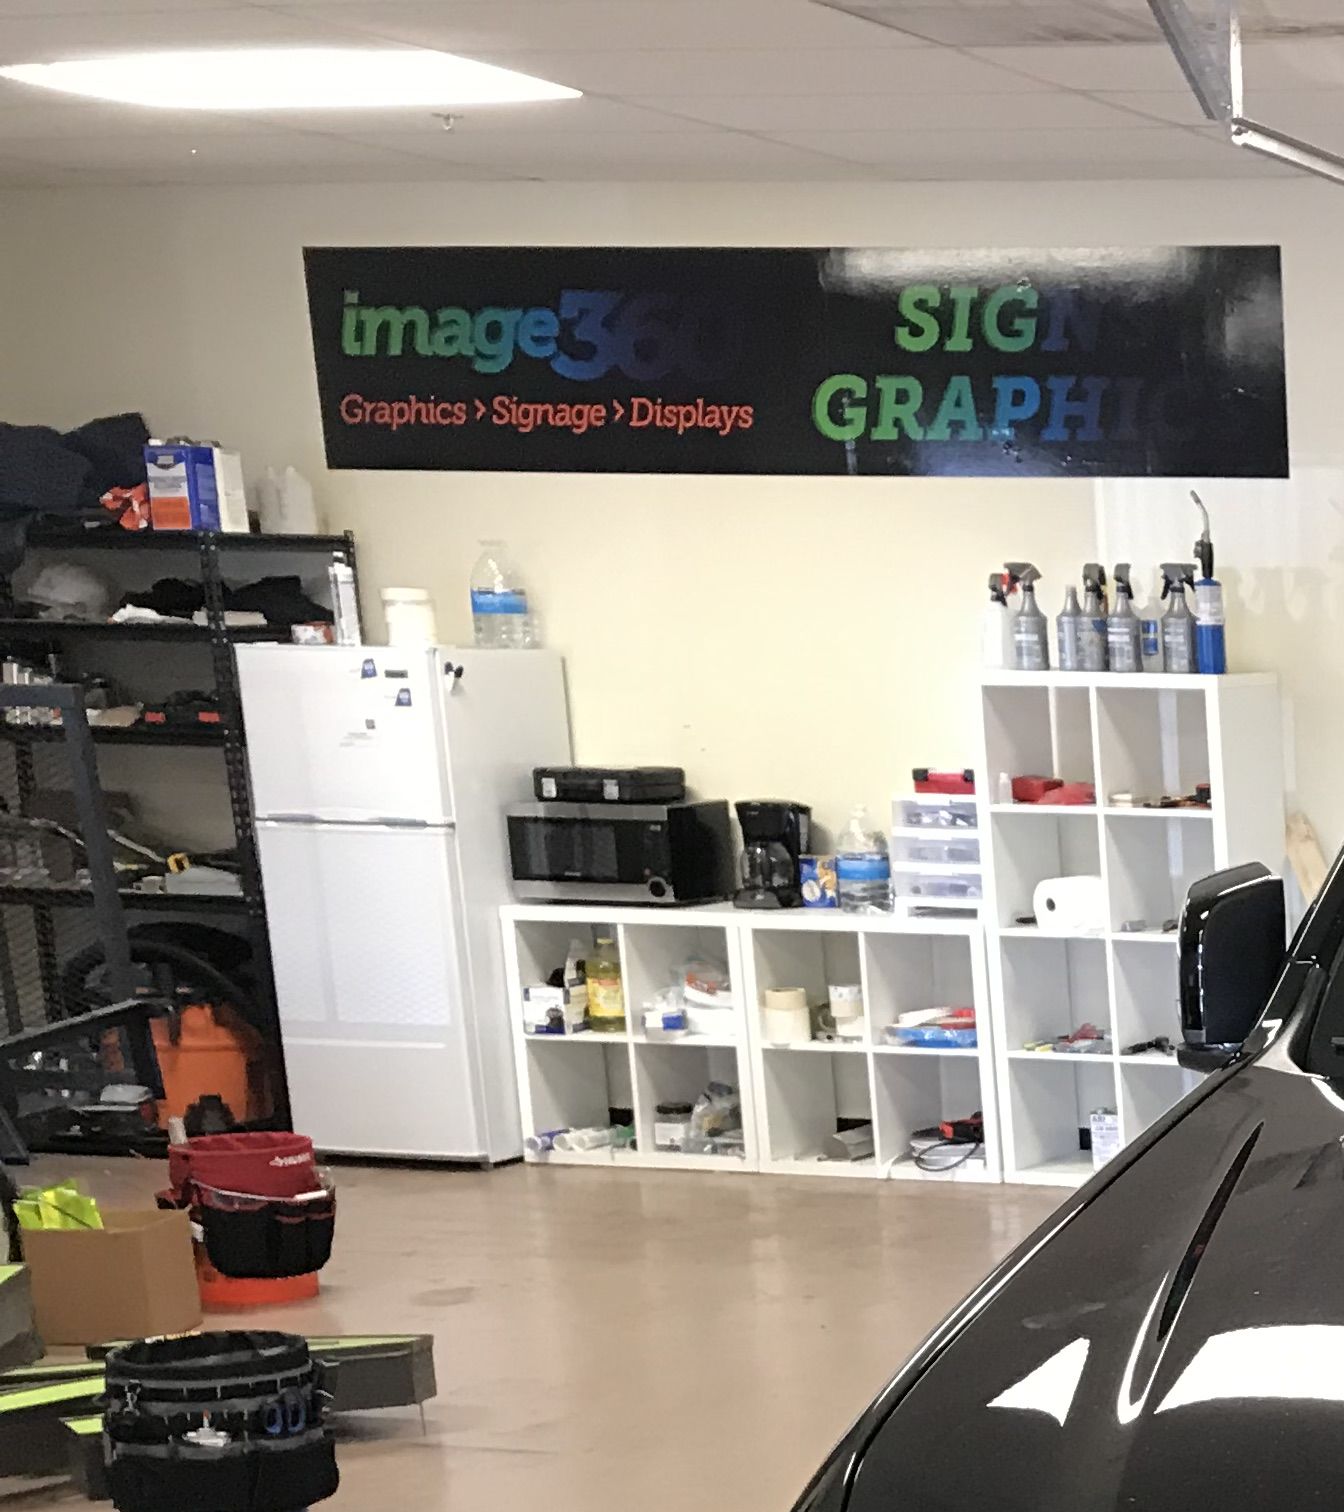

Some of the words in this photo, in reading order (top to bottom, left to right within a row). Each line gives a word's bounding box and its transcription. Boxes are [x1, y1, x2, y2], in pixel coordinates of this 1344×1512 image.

[339, 392, 467, 431] Graphics
[491, 396, 607, 433] Signage
[630, 397, 754, 436] Displays
